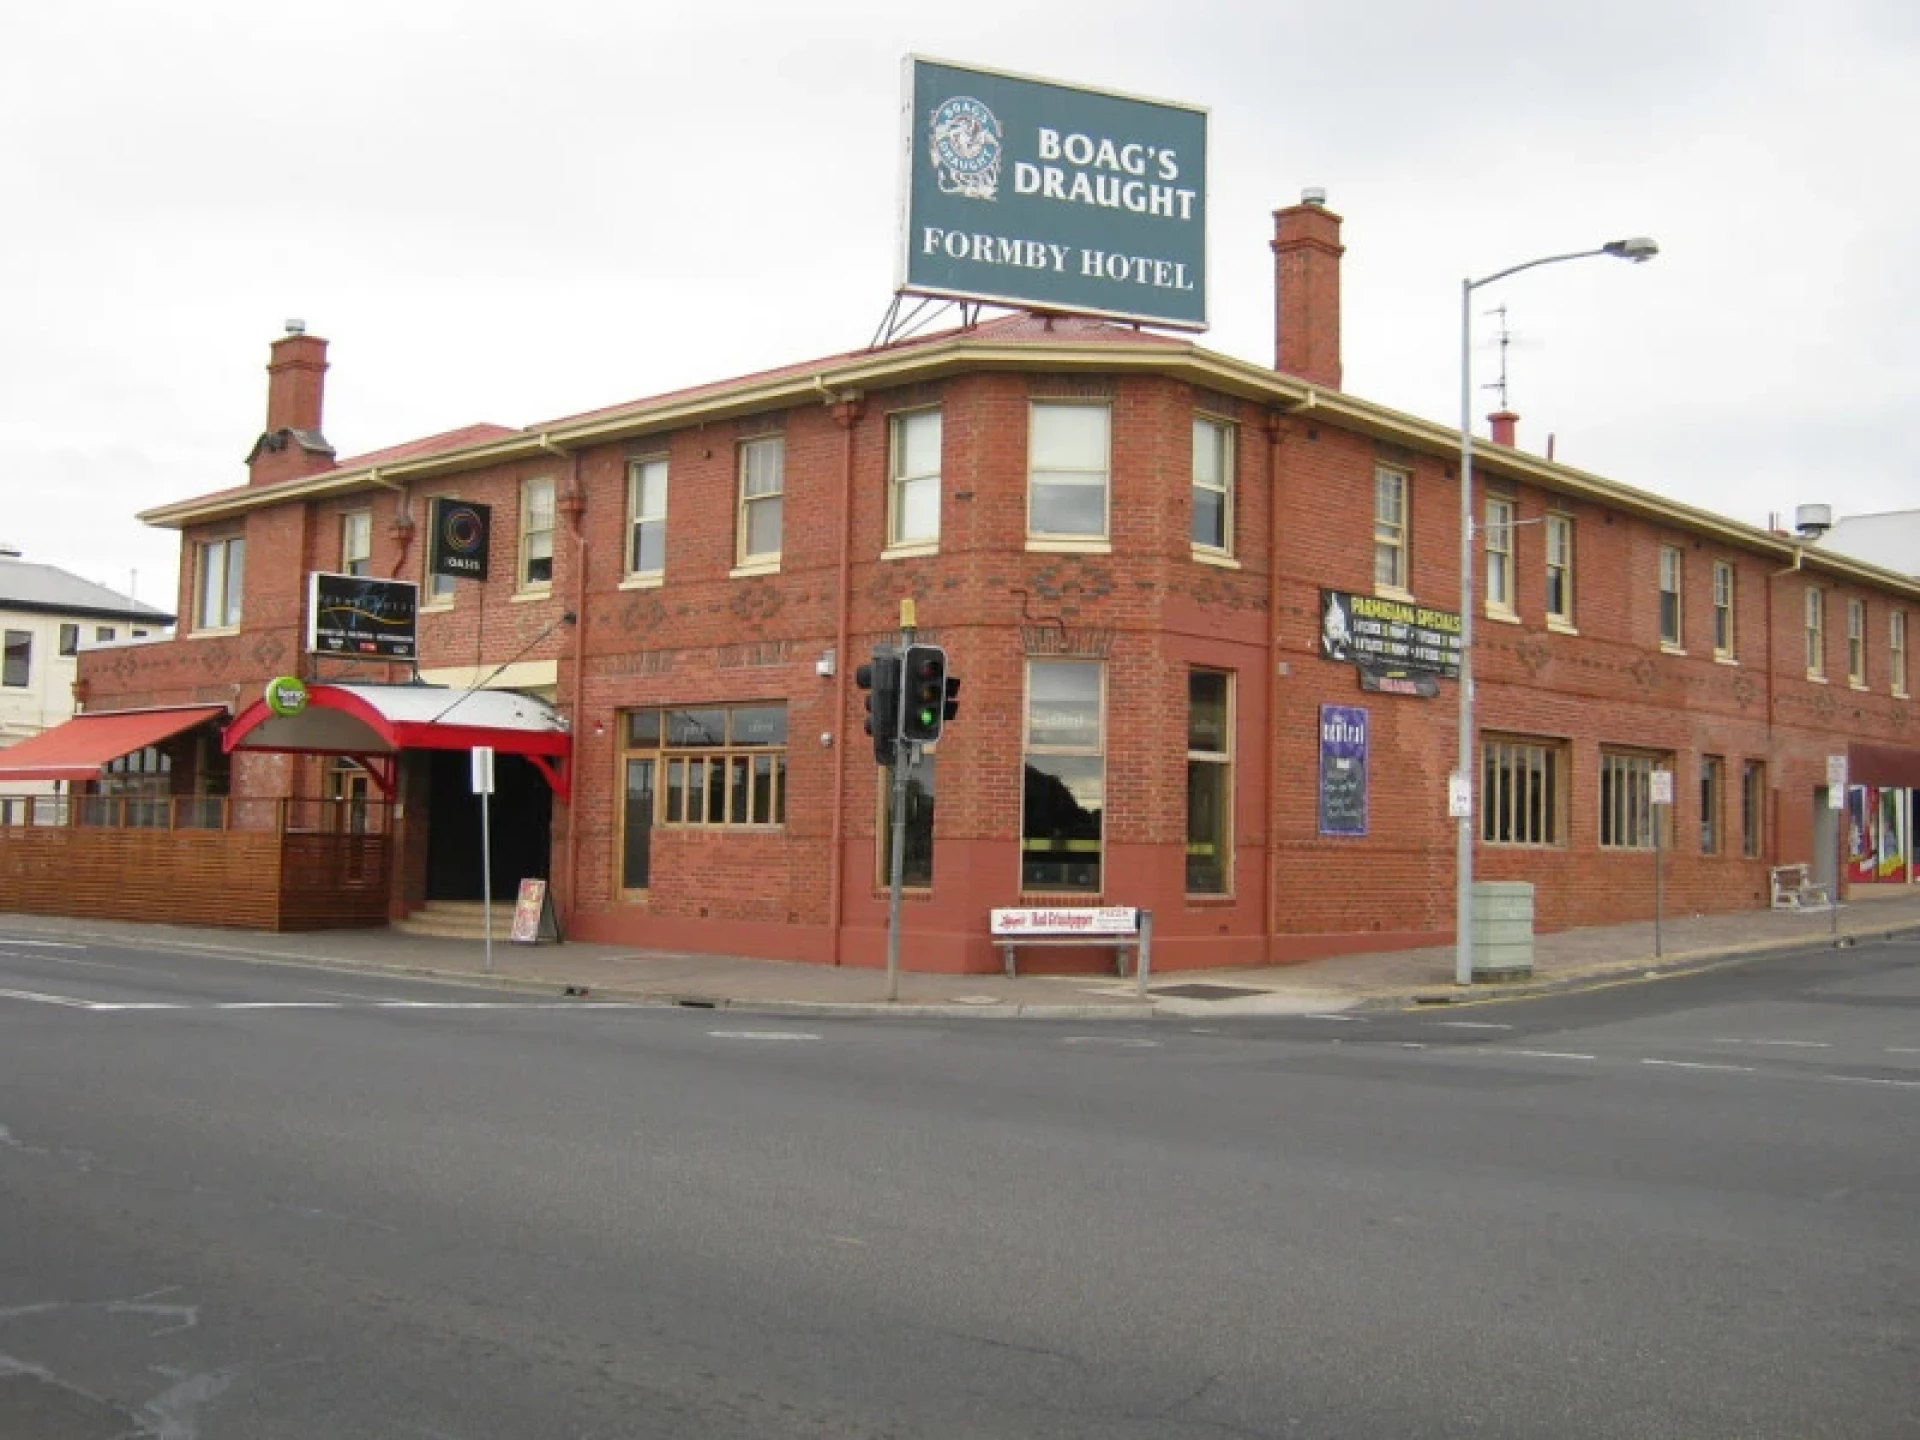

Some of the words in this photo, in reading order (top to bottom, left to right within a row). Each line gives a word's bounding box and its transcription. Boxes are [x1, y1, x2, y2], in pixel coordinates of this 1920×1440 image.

[1038, 127, 1179, 181] BOAG'S
[1014, 162, 1196, 220] DRAUGHT
[923, 227, 1071, 272] FORMBY
[1079, 249, 1194, 290] HOTEL
